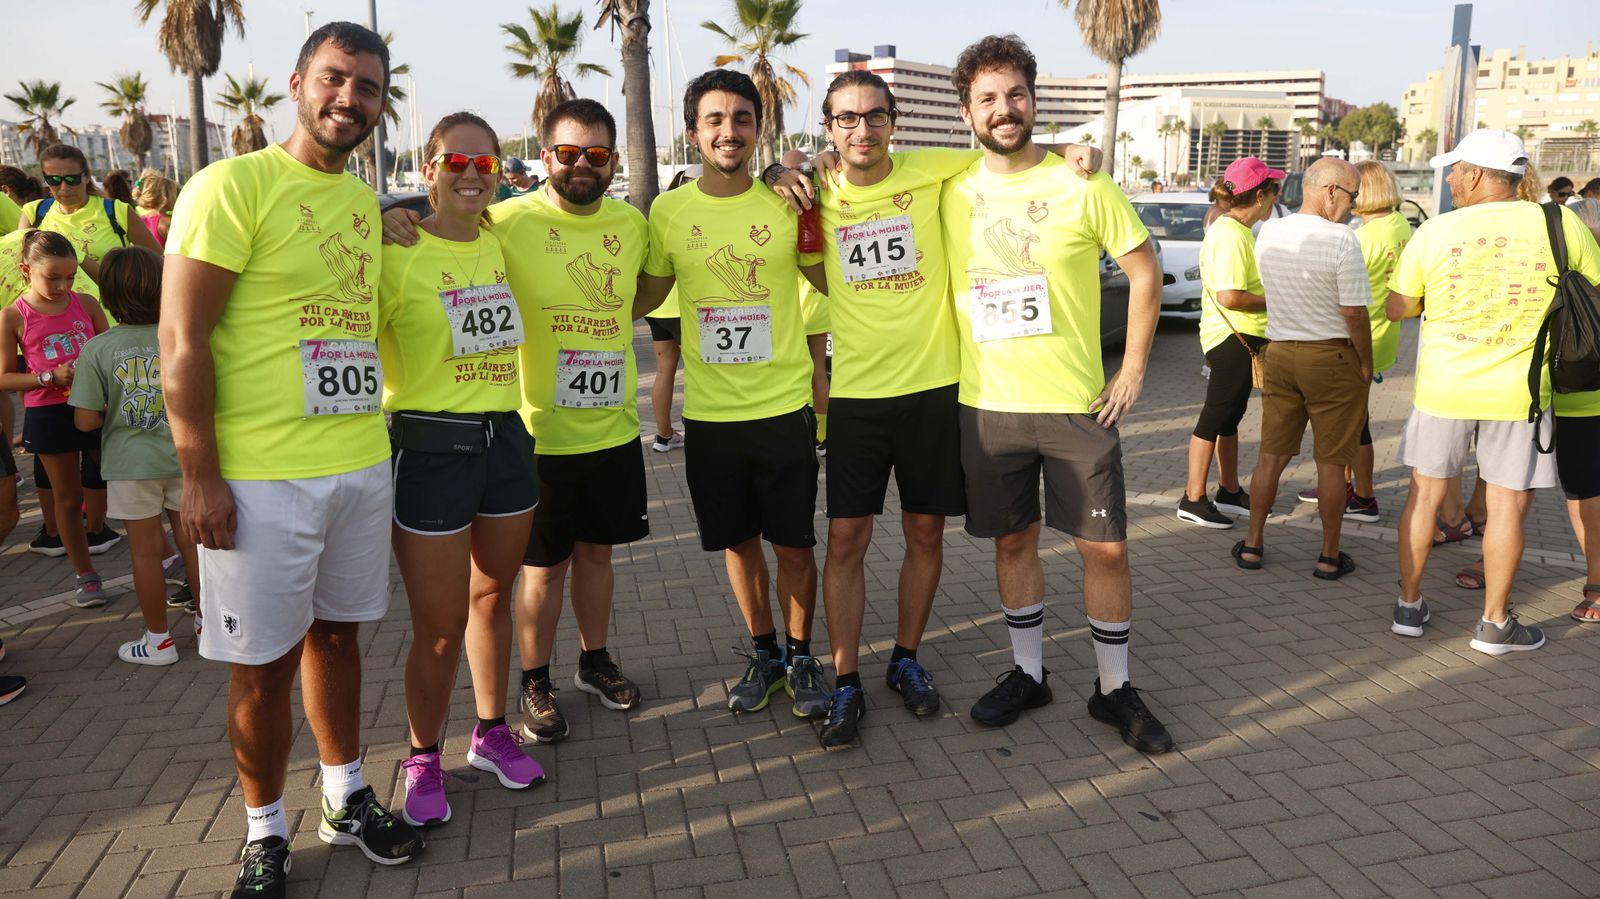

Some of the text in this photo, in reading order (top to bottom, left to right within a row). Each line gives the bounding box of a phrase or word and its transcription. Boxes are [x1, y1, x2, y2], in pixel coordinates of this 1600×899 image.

[879, 224, 907, 234] MUJER
[849, 237, 906, 267] 415
[854, 282, 874, 292] POR
[878, 282, 890, 290] LA
[895, 275, 925, 290] MUJER
[459, 295, 477, 305] POR
[478, 295, 488, 303] LA
[302, 305, 371, 321] VII CARRERA
[740, 313, 767, 321] MUJER
[983, 297, 1039, 327] 855
[299, 317, 372, 333] POR LA MUJER
[461, 305, 515, 337] 482
[553, 315, 617, 328] VII CARRERA
[552, 324, 573, 333] POR
[576, 325, 589, 334] LA
[592, 324, 620, 337] MUJER
[716, 326, 752, 350] 37
[320, 351, 342, 359] POR
[456, 361, 516, 373] VII CARRERA
[318, 365, 378, 397] 805
[455, 372, 476, 383] POR
[569, 371, 620, 395] 401
